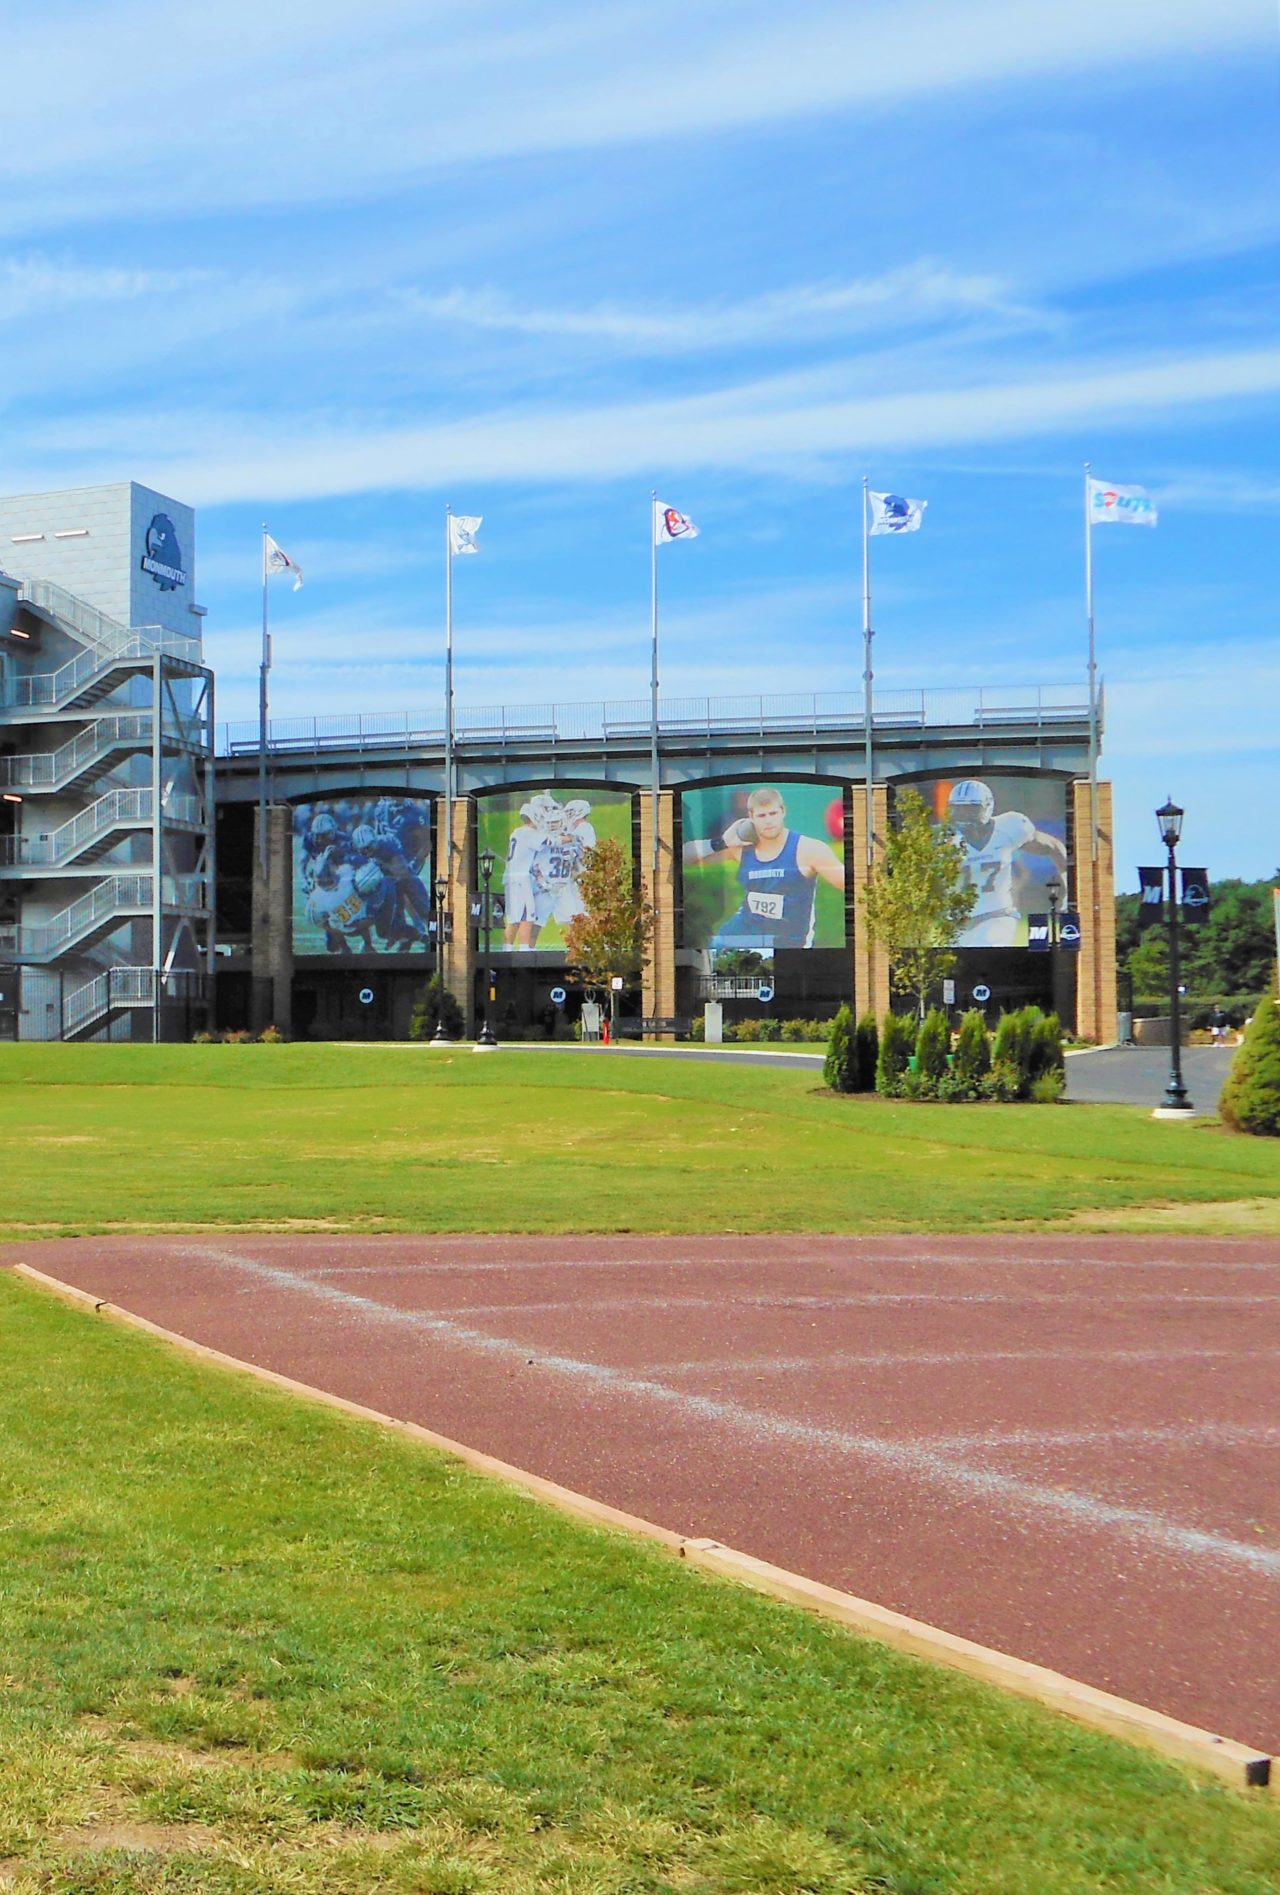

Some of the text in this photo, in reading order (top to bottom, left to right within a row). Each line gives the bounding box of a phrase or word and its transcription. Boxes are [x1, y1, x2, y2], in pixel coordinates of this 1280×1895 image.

[143, 557, 186, 584] MONMOUTH
[752, 899, 777, 915] 792
[1029, 926, 1048, 939] M
[362, 992, 371, 1000] M
[553, 991, 563, 999] M
[760, 990, 770, 998] M
[976, 989, 987, 997] M
